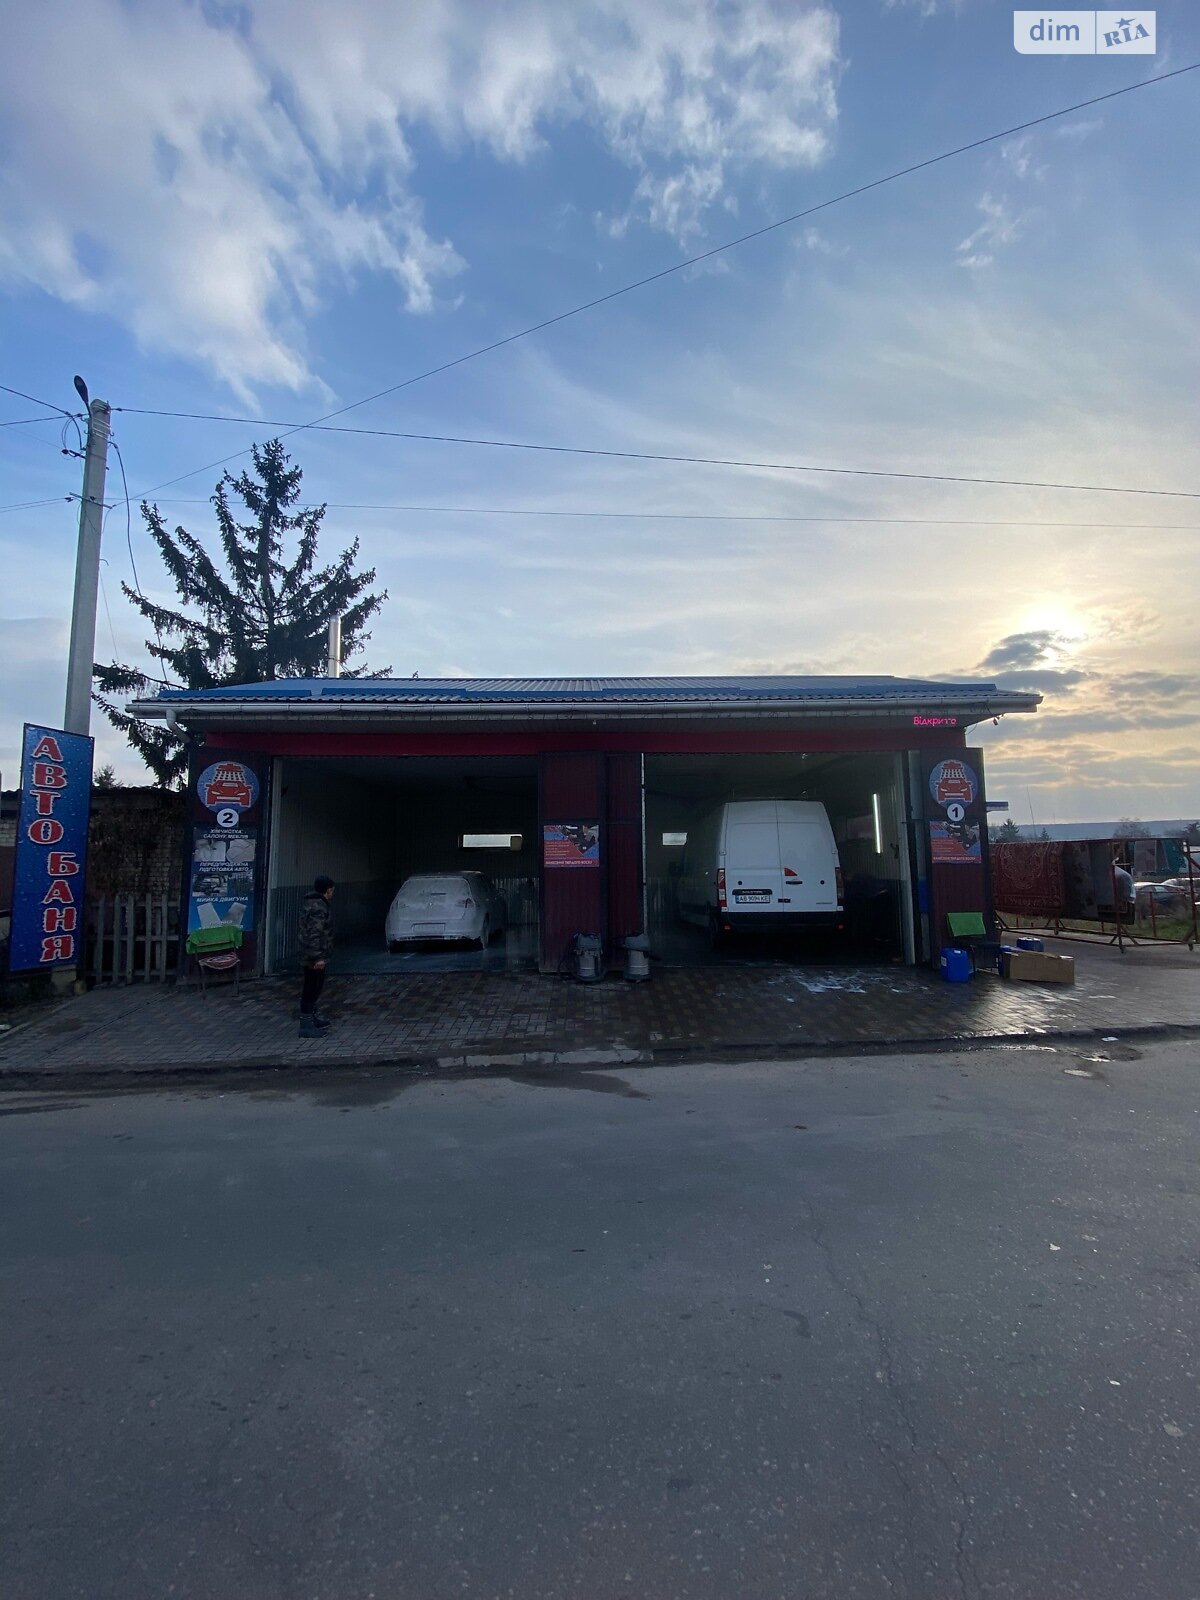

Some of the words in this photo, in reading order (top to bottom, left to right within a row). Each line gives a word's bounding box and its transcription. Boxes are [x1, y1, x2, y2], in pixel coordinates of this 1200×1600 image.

[913, 716, 957, 726] Відкрито
[28, 736, 67, 845] АВТО
[222, 812, 234, 824] 2
[952, 807, 959, 818] 1
[40, 852, 79, 962] БАНЯ
